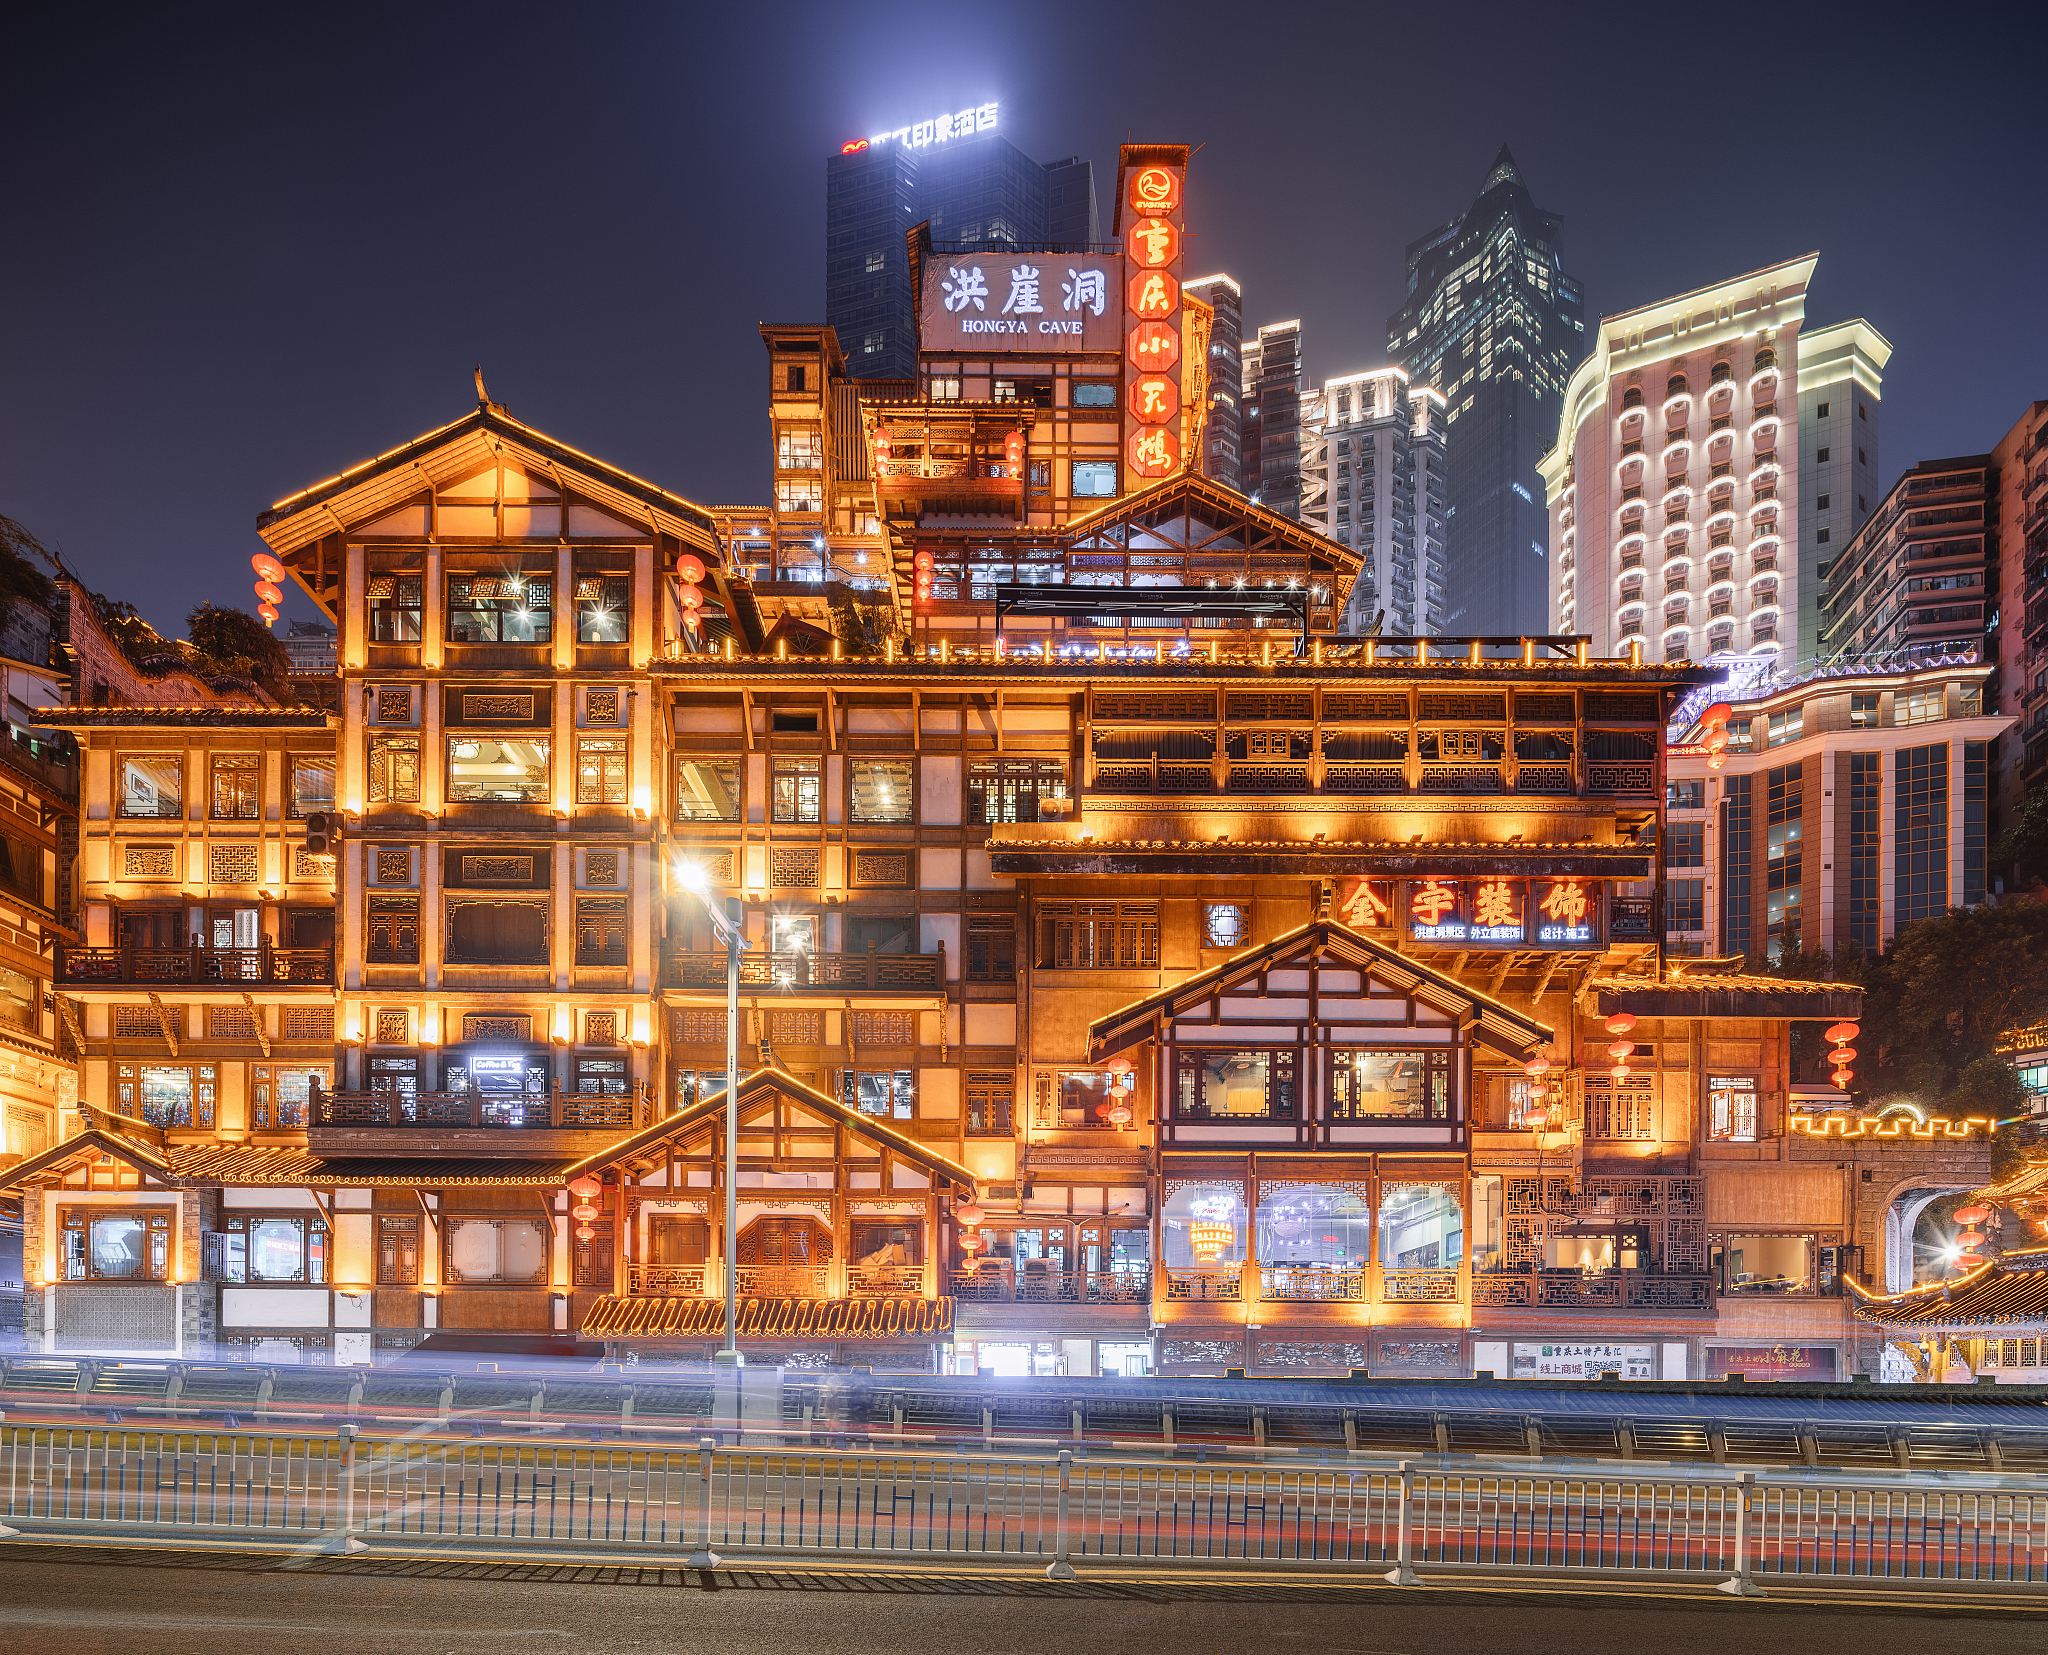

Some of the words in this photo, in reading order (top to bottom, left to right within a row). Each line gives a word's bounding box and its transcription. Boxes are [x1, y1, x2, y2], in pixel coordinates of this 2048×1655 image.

[941, 264, 1106, 316] 洪崖洞
[962, 320, 1028, 334] HONGYA
[1038, 321, 1083, 334] CAVE
[1136, 221, 1172, 470] 重庆小天鹅
[1341, 880, 1587, 927] 金宇装饰
[1470, 926, 1522, 940] 外立面装饰
[1553, 1345, 1622, 1357] 重庆土特产总汇
[1540, 1363, 1583, 1375] 线上商城
